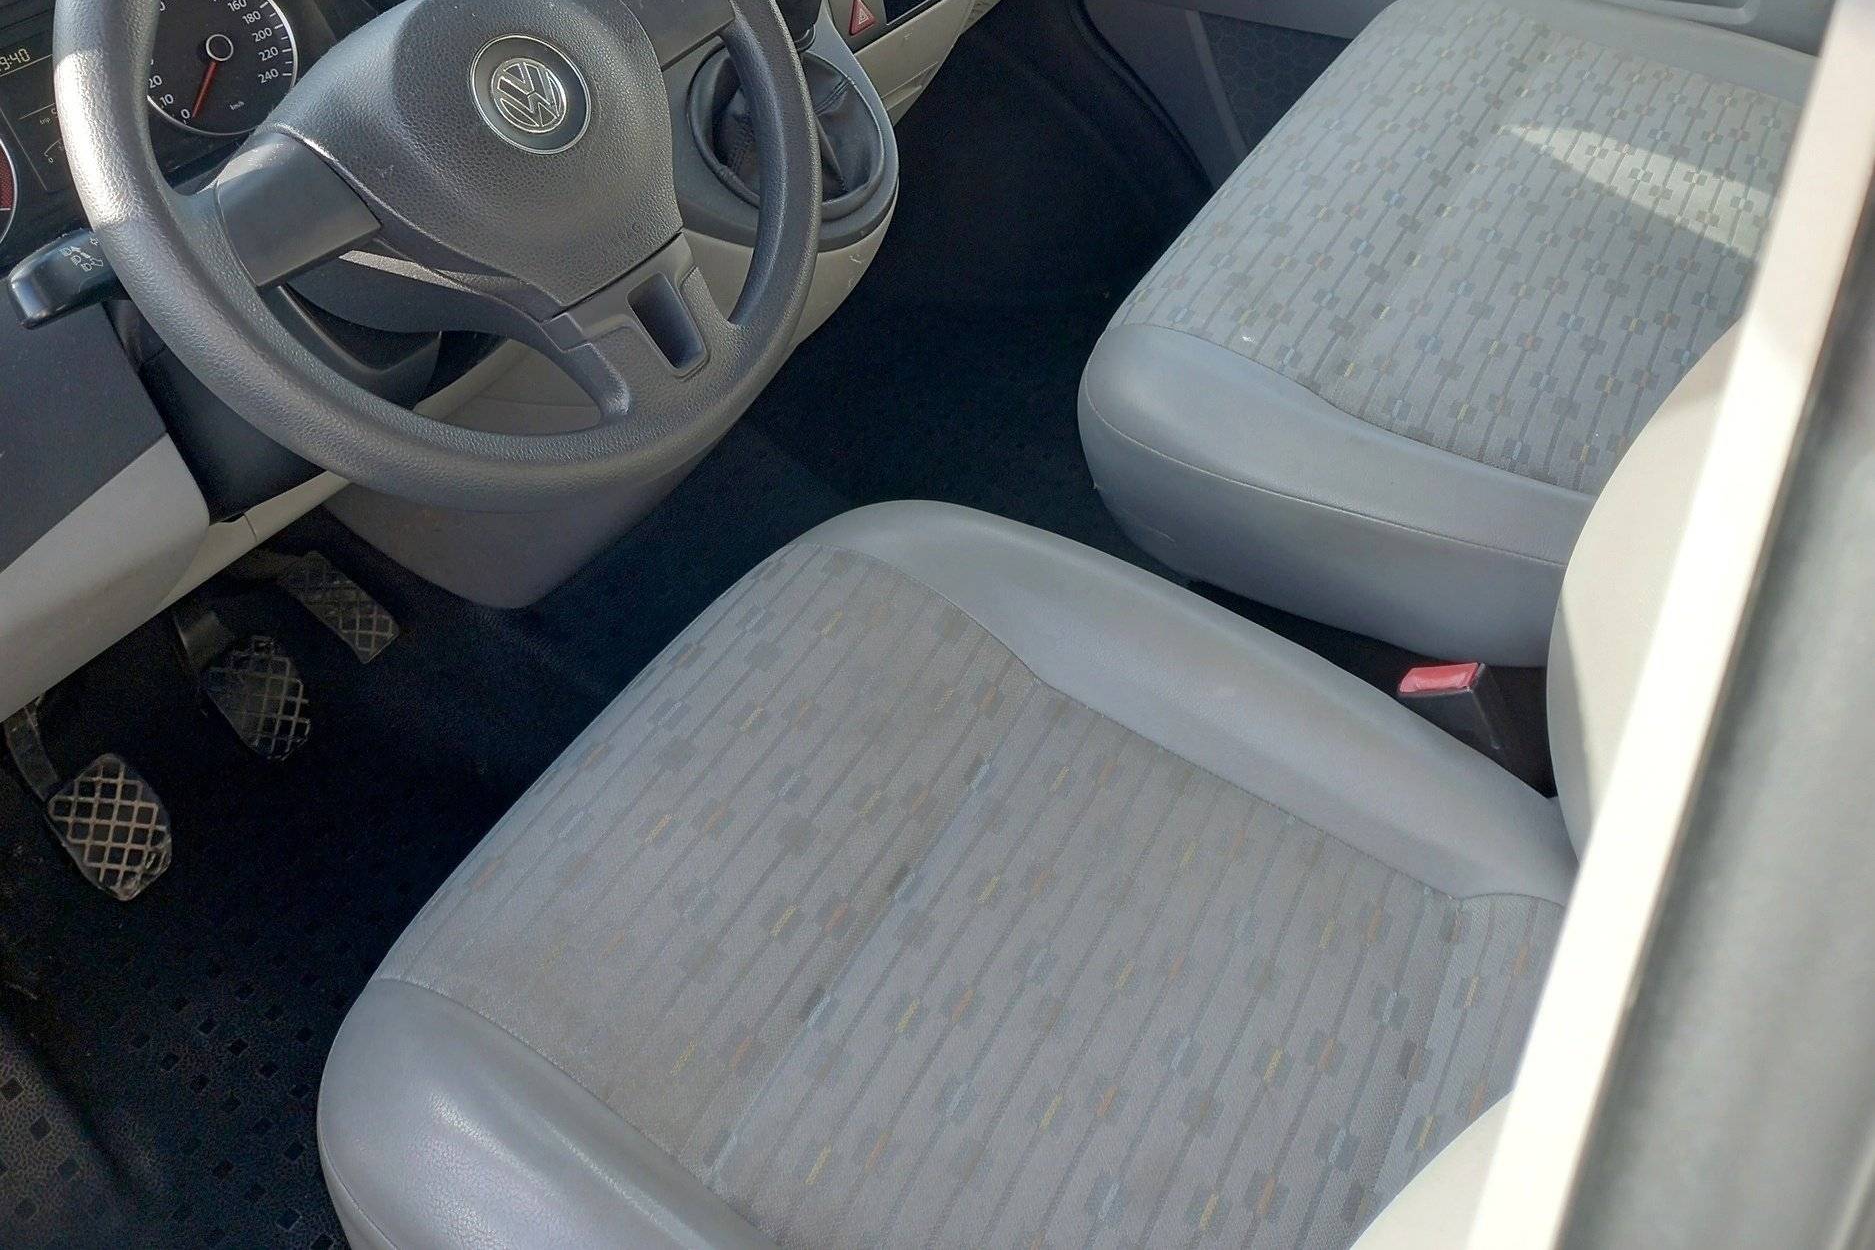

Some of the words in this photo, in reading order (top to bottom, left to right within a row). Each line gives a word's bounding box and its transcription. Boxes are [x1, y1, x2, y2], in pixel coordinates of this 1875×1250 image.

[241, 10, 261, 25] 180
[251, 27, 273, 42] 200
[258, 46, 279, 61] 220
[148, 74, 163, 89] 20
[257, 68, 279, 84] 240
[159, 93, 174, 107] 10
[180, 108, 190, 120] 0
